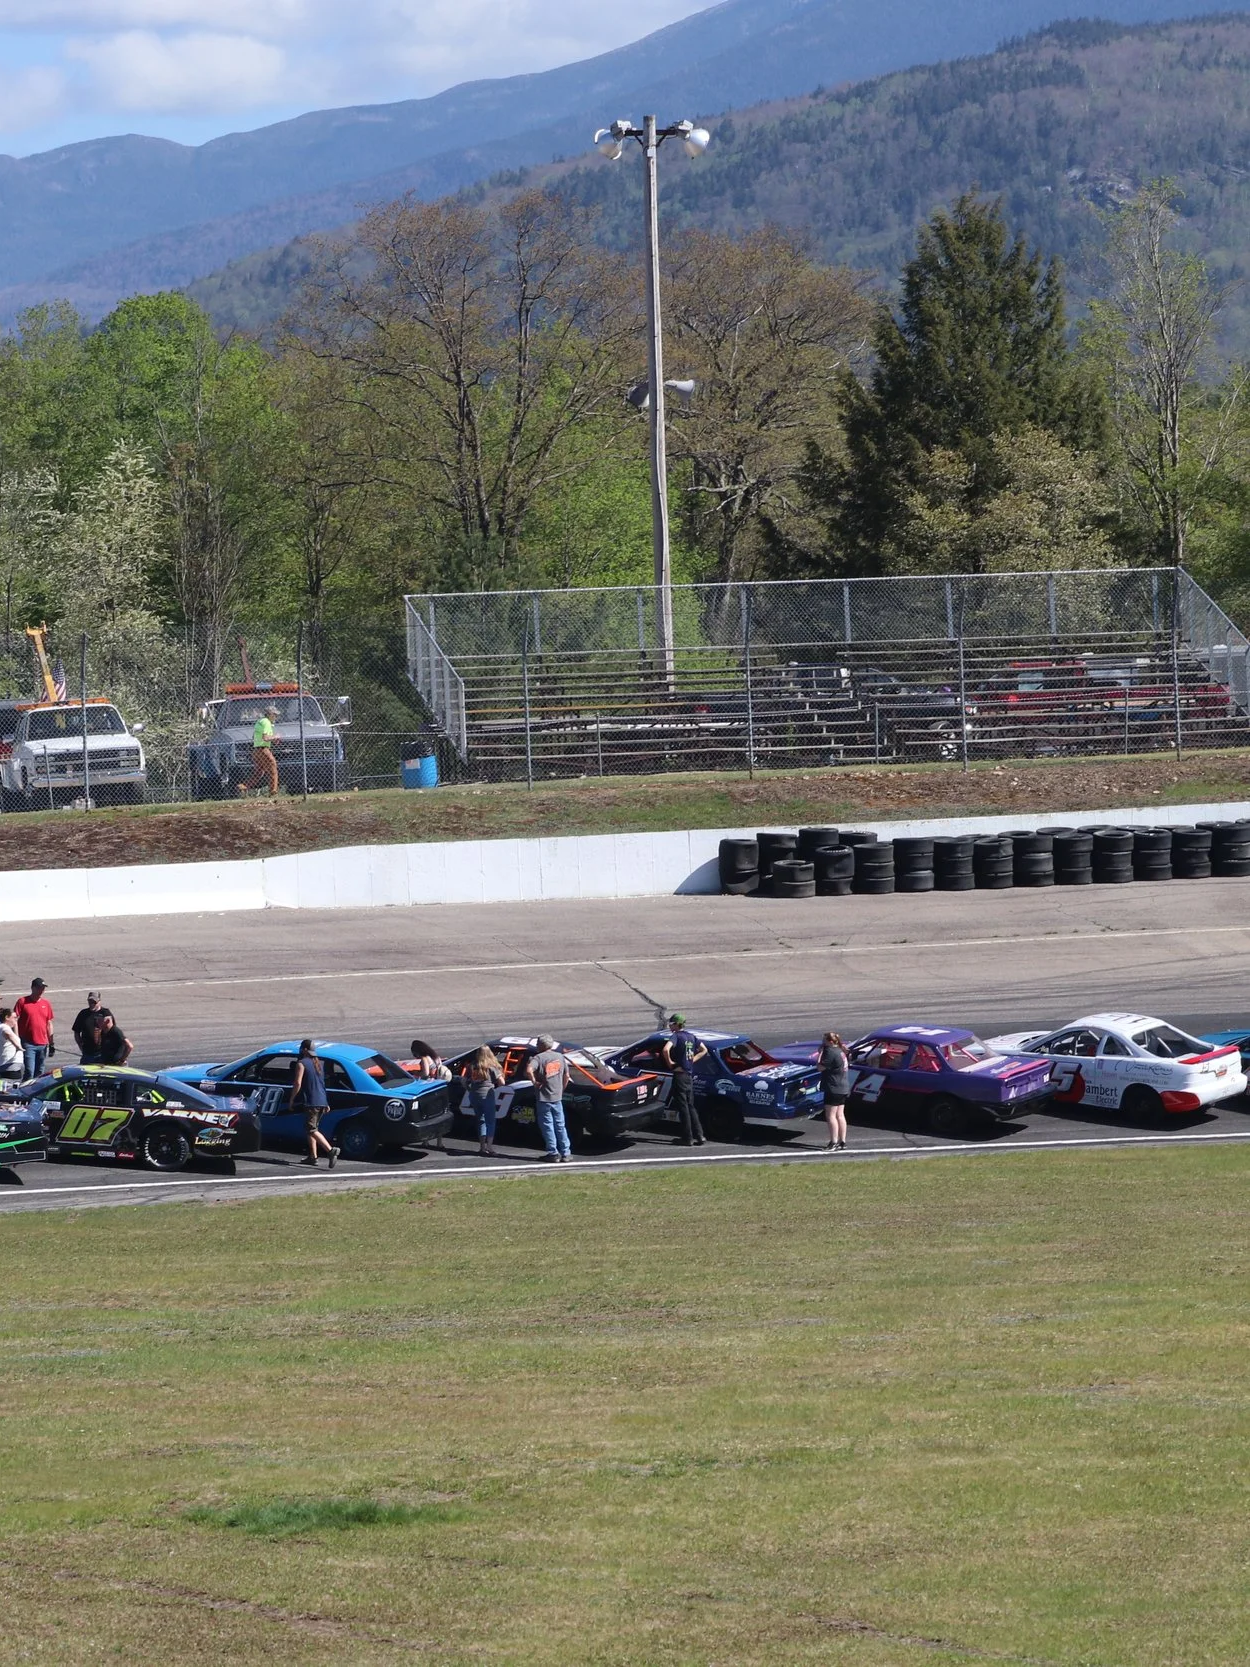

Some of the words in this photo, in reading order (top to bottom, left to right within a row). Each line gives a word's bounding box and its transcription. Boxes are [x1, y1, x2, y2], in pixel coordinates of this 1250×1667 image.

[1049, 1060, 1083, 1093] 5
[57, 1107, 132, 1142] 07
[142, 1108, 235, 1127] VARNEY
[195, 1137, 231, 1146] Logging
